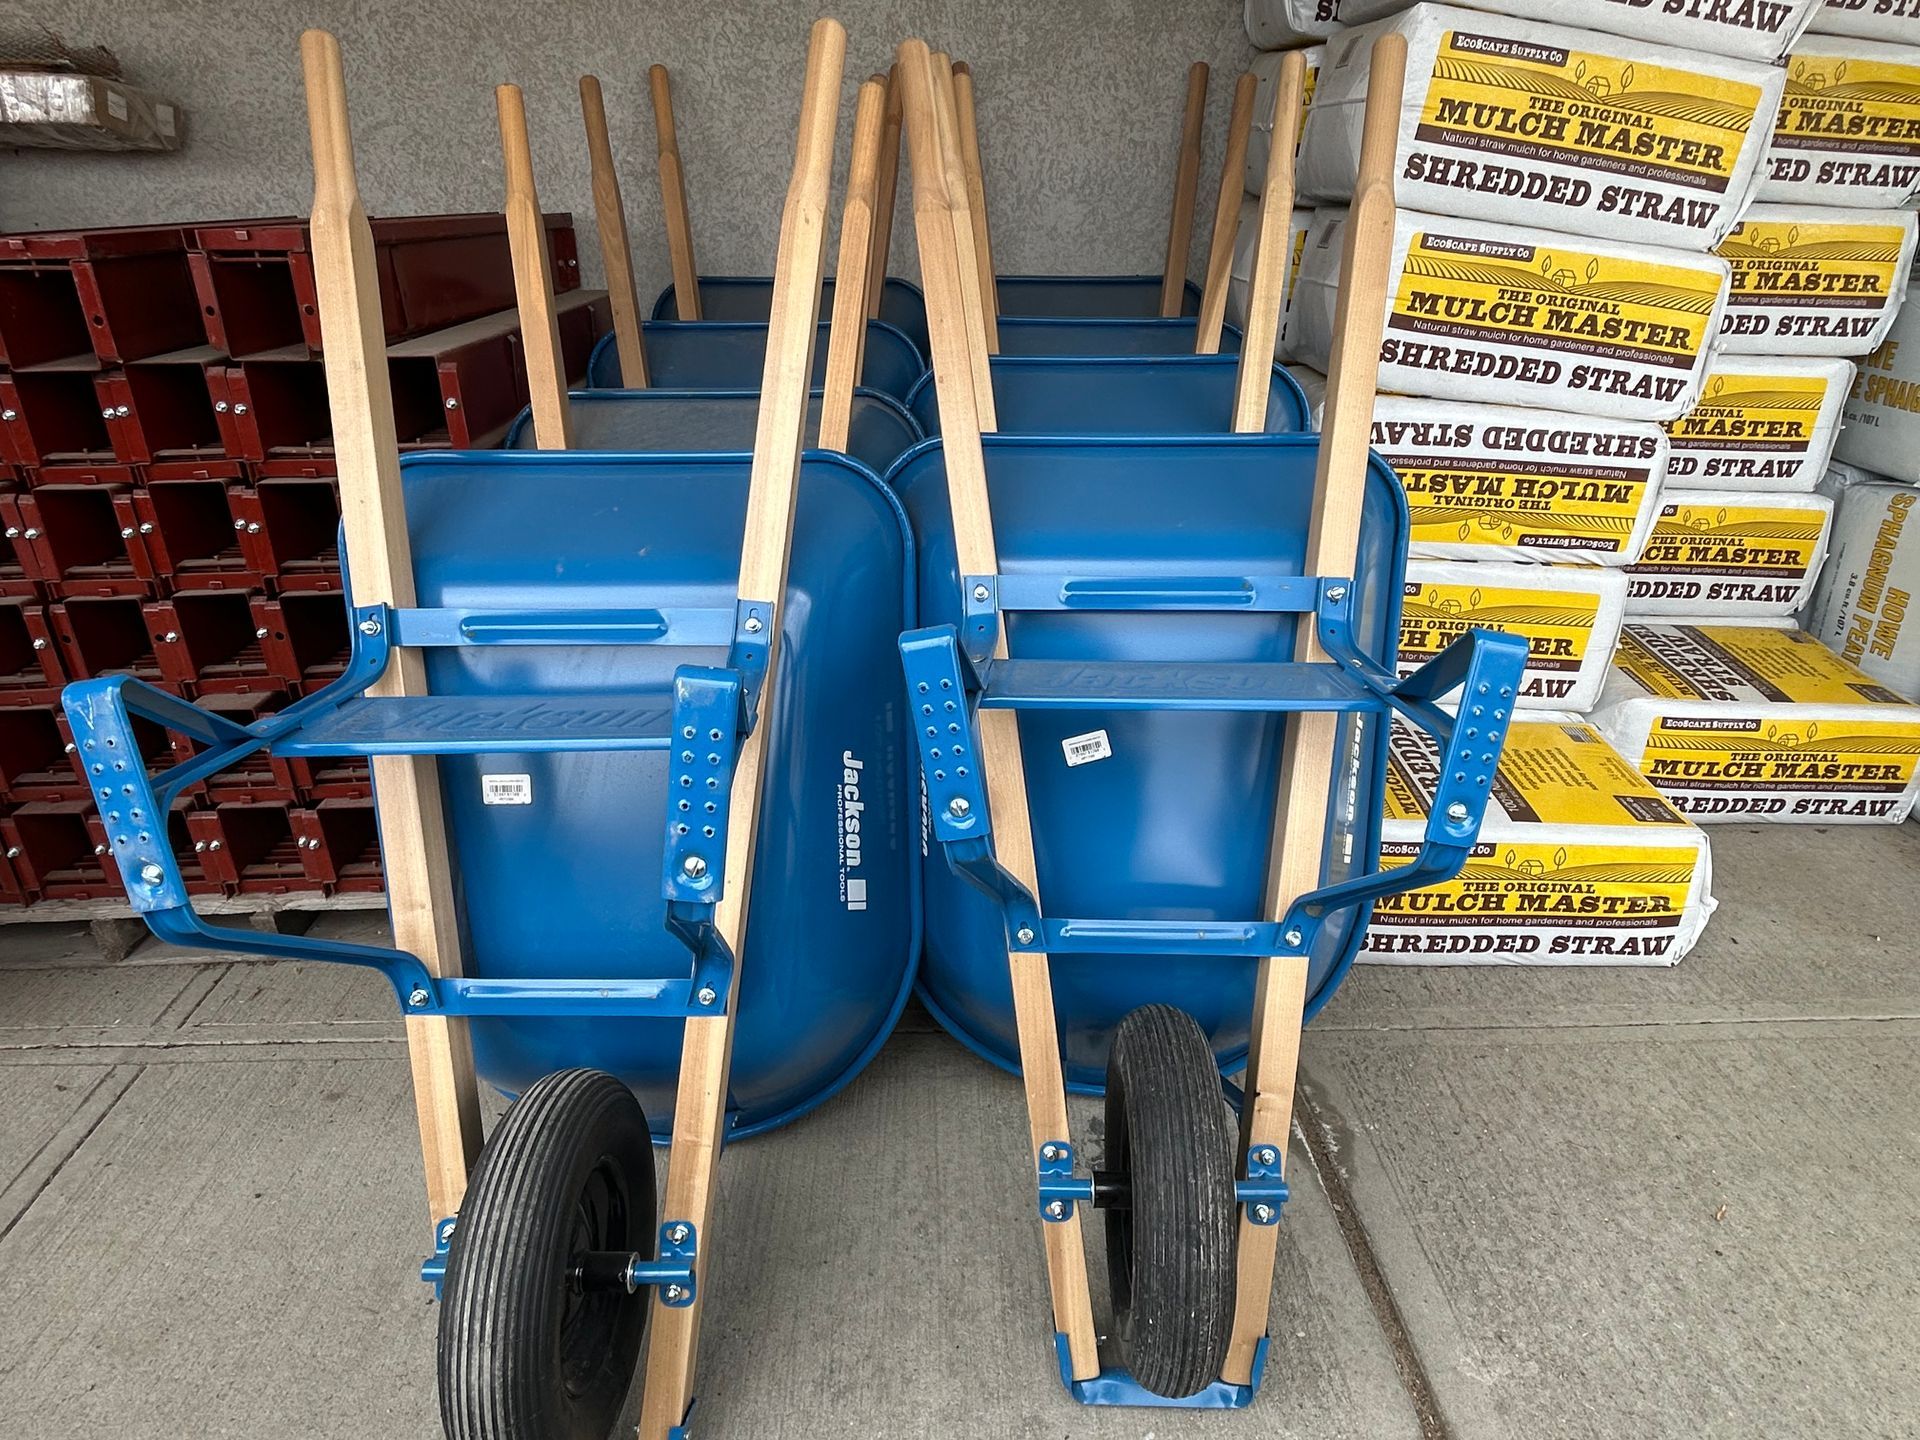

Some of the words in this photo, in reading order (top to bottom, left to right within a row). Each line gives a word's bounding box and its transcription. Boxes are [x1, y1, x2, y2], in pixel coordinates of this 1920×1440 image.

[1456, 35, 1509, 55] EcoScape
[1510, 44, 1550, 60] Supply
[1550, 51, 1563, 63] Co
[1529, 96, 1566, 115] THE
[1568, 103, 1654, 130] ORIGINAL
[1789, 98, 1864, 113] ORIGINAL
[1435, 97, 1570, 141] MULCH
[1575, 121, 1728, 171] MASTER
[1441, 131, 1477, 146] Natural
[1480, 138, 1506, 151] straw
[1508, 141, 1537, 156] mulch
[1538, 146, 1552, 159] for
[1554, 149, 1578, 163] home
[1580, 155, 1626, 173] gardeners
[1629, 162, 1646, 174] and
[1647, 165, 1707, 186] professionals
[1816, 161, 1920, 188] STRAW
[1403, 152, 1592, 206] SHREDDED
[1596, 185, 1720, 229] STRAW
[1426, 237, 1479, 252] EcoScape
[1480, 243, 1517, 257] Supply
[1518, 248, 1530, 259] Co
[1728, 260, 1744, 269] HE
[1747, 261, 1819, 272] ORIGINAL
[1754, 272, 1883, 293] MASTER
[1498, 289, 1533, 302] THE
[1536, 294, 1620, 315] ORIGINAL
[1406, 291, 1538, 328] MULCH
[1543, 313, 1693, 351] MASTER
[1775, 316, 1880, 337] STRAW
[1413, 320, 1450, 333] Natural
[1452, 325, 1477, 338] straw
[1479, 328, 1506, 341] mulch
[1508, 332, 1522, 343] for
[1523, 334, 1549, 346] home
[1550, 339, 1595, 354] gardeners
[1597, 344, 1614, 355] and
[1616, 346, 1674, 365] professionals
[1379, 339, 1562, 385] SHREDDED
[1567, 365, 1688, 403] STRAW
[1689, 408, 1743, 418] IGINAL
[1684, 419, 1806, 438] MASTER
[1481, 426, 1658, 459] SHREDDED
[1434, 460, 1450, 468] and
[1452, 458, 1497, 470] gardeners
[1499, 462, 1524, 472] home
[1526, 464, 1538, 474] for
[1541, 465, 1567, 475] mulch
[1570, 467, 1593, 476] straw
[1595, 468, 1626, 478] Natural
[1703, 458, 1804, 478] STRAW
[1396, 472, 1506, 496] MAST
[1511, 478, 1633, 504] MULCH
[1433, 495, 1515, 508] ORIGINAL
[1518, 500, 1551, 511] THE
[1664, 506, 1675, 514] Co
[1570, 538, 1616, 550] EcoScape
[1652, 537, 1677, 545] THE
[1679, 538, 1745, 547] ORIGINAL
[1686, 547, 1803, 565] MASTER
[1856, 493, 1917, 615] SPHAGNUM
[1405, 585, 1416, 593] Co
[1627, 581, 1702, 599] DDED
[1706, 583, 1800, 603] STRAW
[1401, 619, 1423, 629] HE
[1869, 586, 1911, 661] HOWE
[1841, 614, 1874, 668] PEAT
[1406, 653, 1417, 661] for
[1623, 624, 1739, 701] SHREDDED
[1661, 634, 1748, 686] STRAW
[1666, 719, 1711, 729] EcoScape
[1712, 721, 1745, 730] Supply
[1746, 722, 1757, 730] Co
[1731, 753, 1761, 762] THE
[1763, 753, 1838, 762] ORIGINAL
[1650, 759, 1766, 778] MULCH
[1771, 763, 1905, 781] MASTER
[1690, 780, 1712, 788] straw
[1714, 781, 1739, 789] mulch
[1740, 782, 1751, 790] for
[843, 750, 864, 866] Jackson
[1664, 796, 1786, 814] REDDED
[1791, 799, 1899, 817] STRAW
[1382, 844, 1421, 855] EcoSca
[1477, 845, 1490, 855] Co
[1463, 882, 1500, 893] THE
[1503, 882, 1595, 894] ORIGINAL
[1374, 893, 1507, 913] MULCH
[1514, 894, 1677, 914] MASTER
[1380, 915, 1417, 923] Natural
[1449, 916, 1478, 924] mulch
[1480, 916, 1494, 924] for
[1525, 917, 1573, 926] gardeners
[1596, 919, 1658, 927] professionals
[1548, 935, 1676, 956] STRAW
